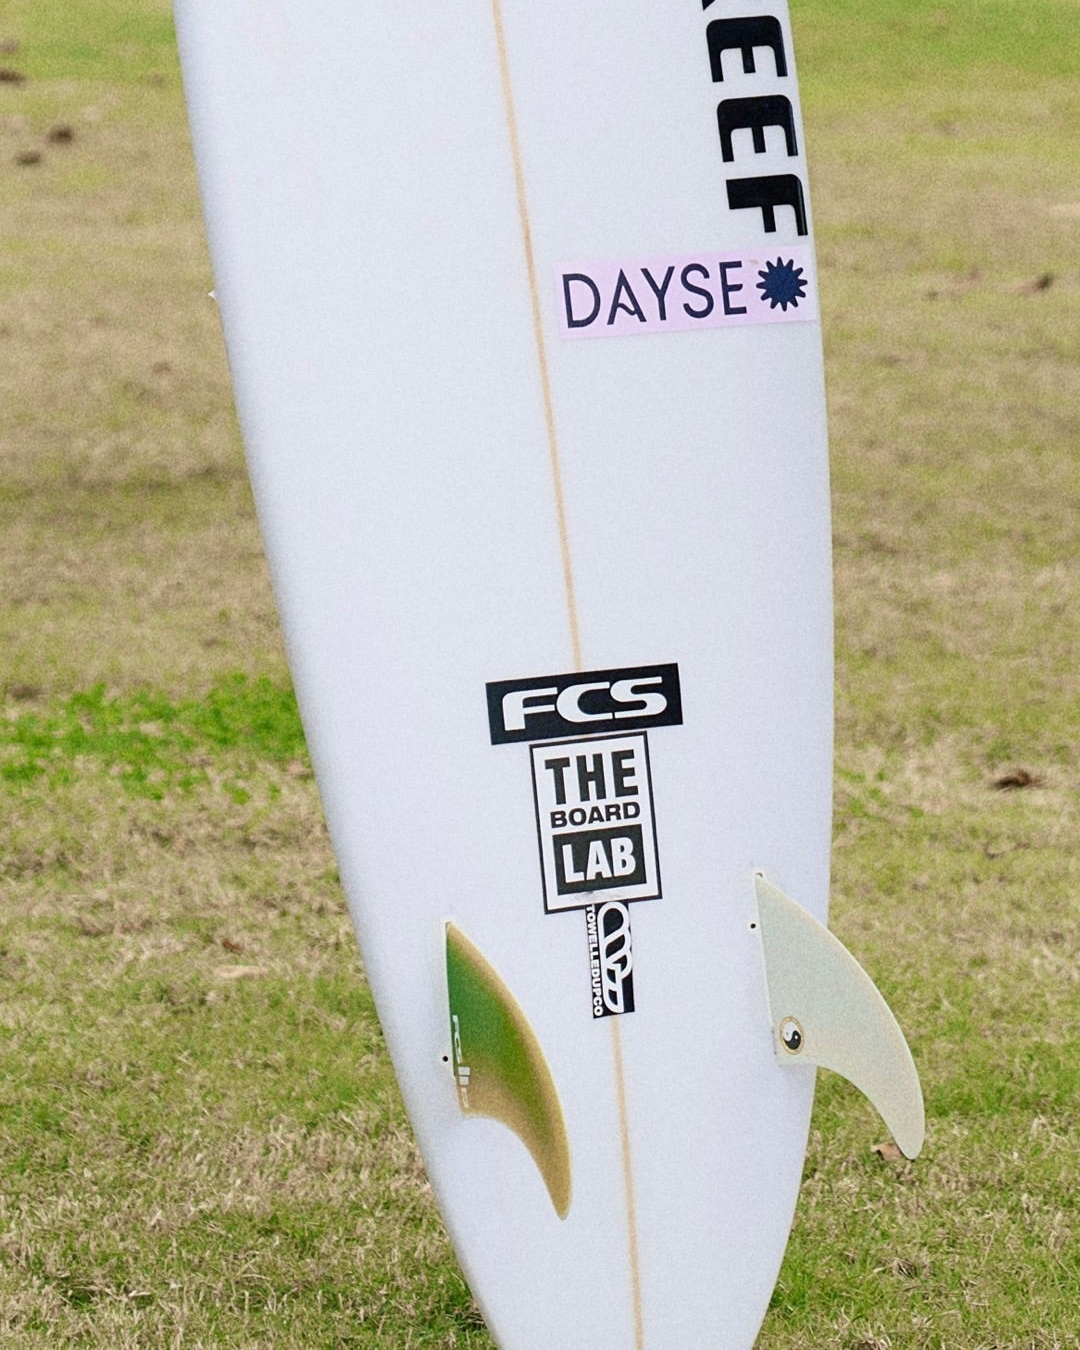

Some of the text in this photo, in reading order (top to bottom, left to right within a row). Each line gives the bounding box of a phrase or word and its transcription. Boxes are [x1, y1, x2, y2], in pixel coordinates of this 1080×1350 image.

[562, 260, 748, 329] DAYSE
[502, 676, 668, 731] FCS
[544, 749, 639, 805] THE
[550, 801, 641, 828] BOARD
[562, 836, 637, 883] LAB
